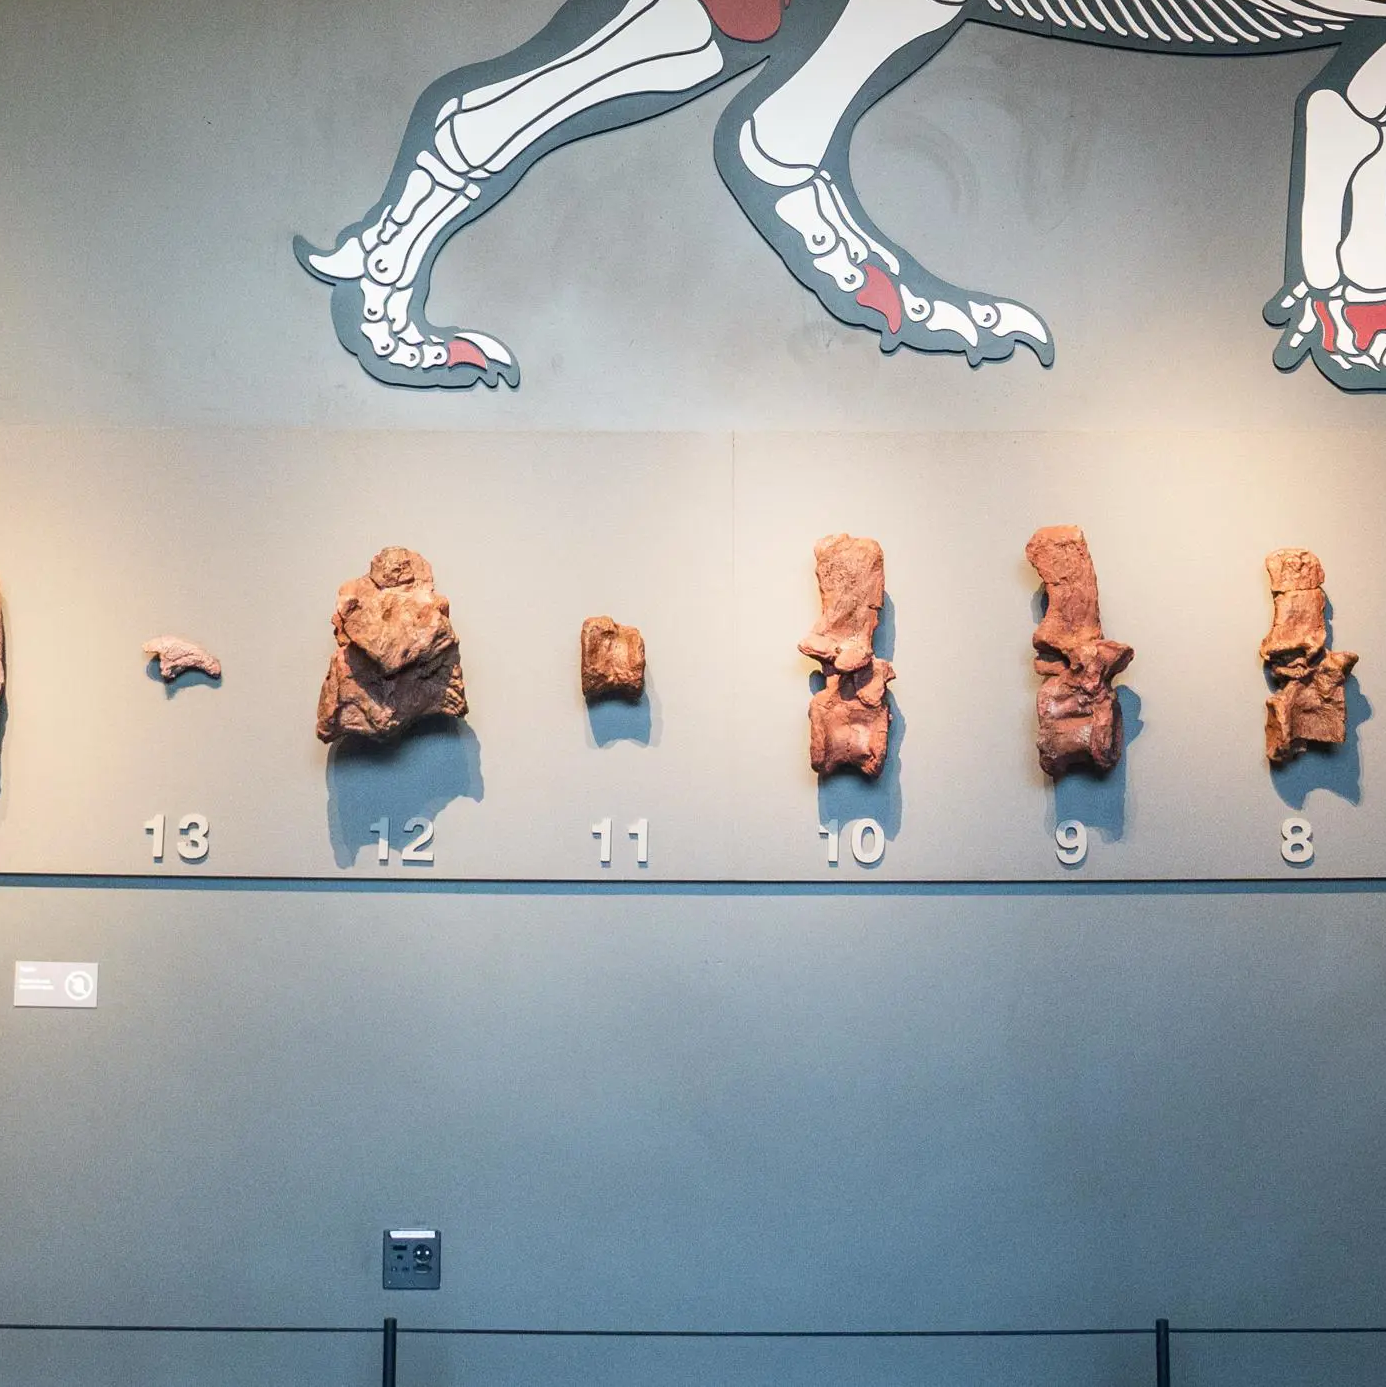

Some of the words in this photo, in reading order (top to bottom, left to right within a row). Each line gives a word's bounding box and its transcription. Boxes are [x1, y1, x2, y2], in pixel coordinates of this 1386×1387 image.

[144, 813, 210, 859] 13
[370, 817, 435, 861] 12
[592, 817, 649, 863] 11
[819, 818, 886, 863] 10
[1055, 819, 1088, 864] 9
[1280, 818, 1314, 863] 8
